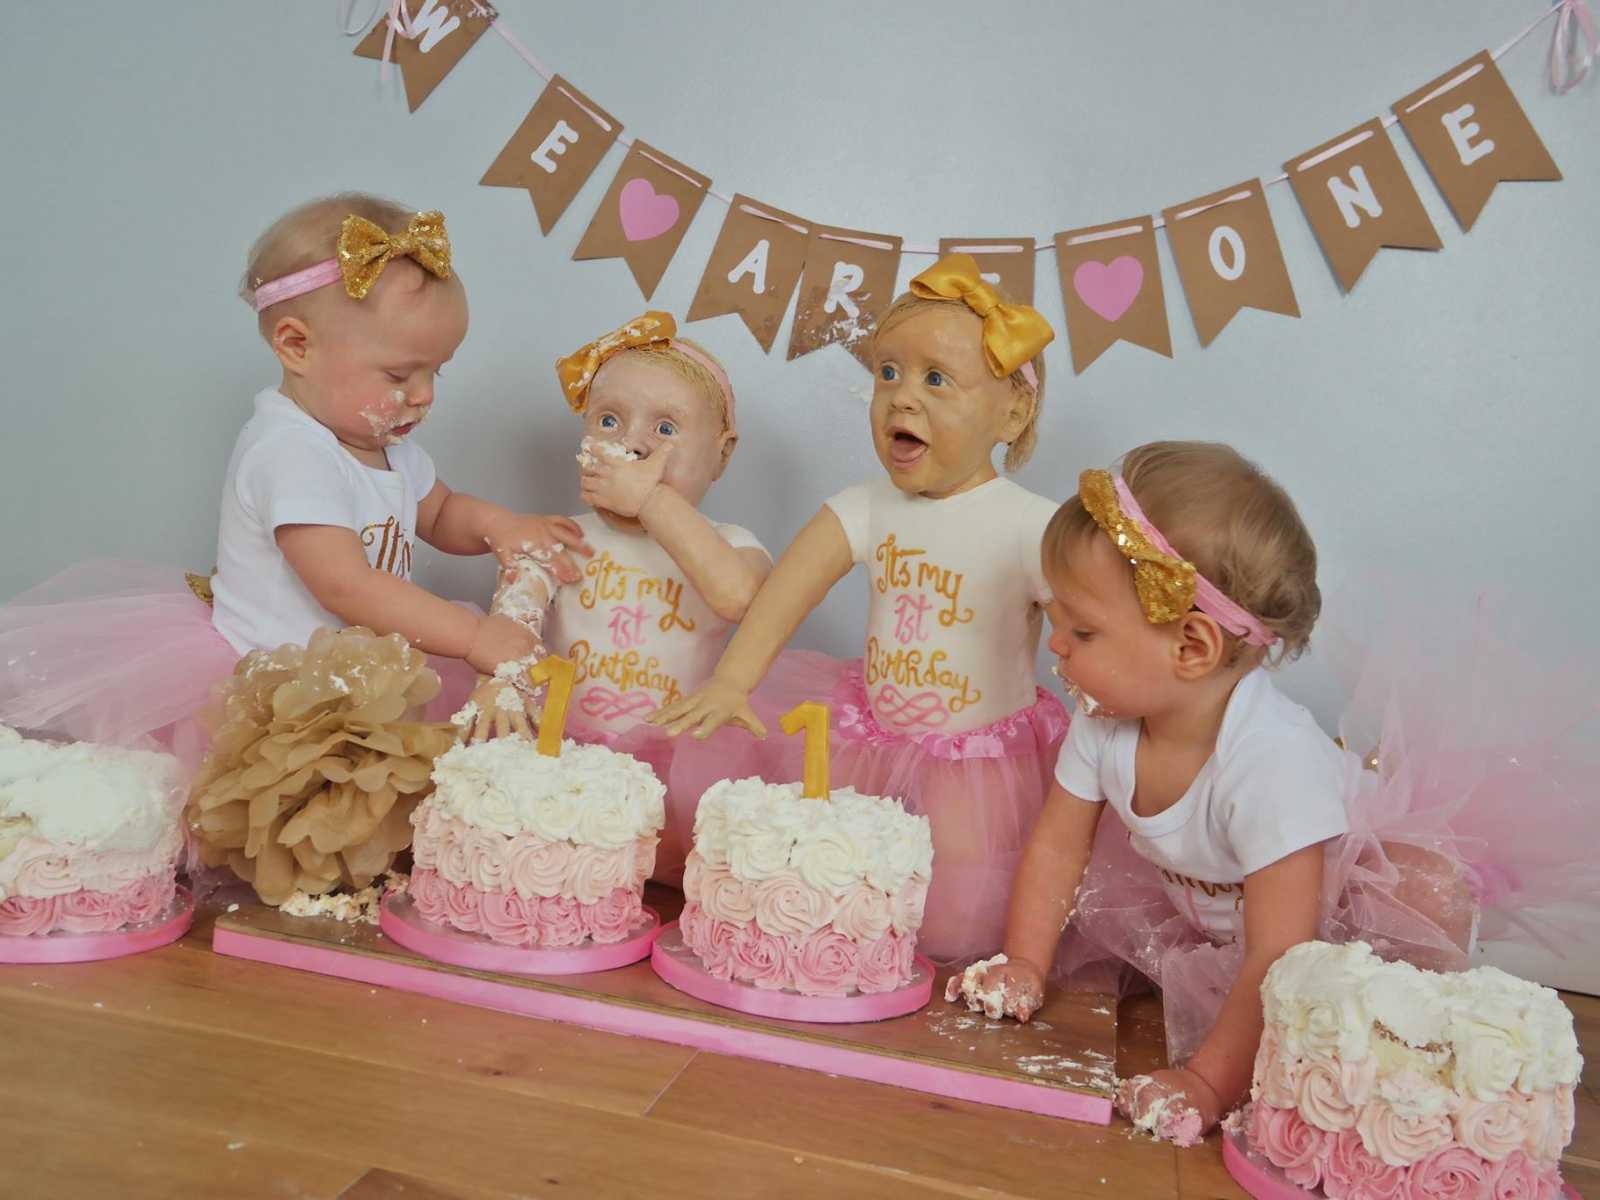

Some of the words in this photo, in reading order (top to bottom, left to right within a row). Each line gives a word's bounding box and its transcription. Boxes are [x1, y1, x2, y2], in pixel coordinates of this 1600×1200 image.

[637, 576, 695, 632] my
[894, 593, 933, 645] 1st
[918, 562, 974, 626] my
[607, 604, 655, 650] 1st
[568, 640, 683, 706] Birthday
[865, 636, 982, 713] Birthday
[528, 654, 577, 759] 1
[779, 700, 830, 803] 1
